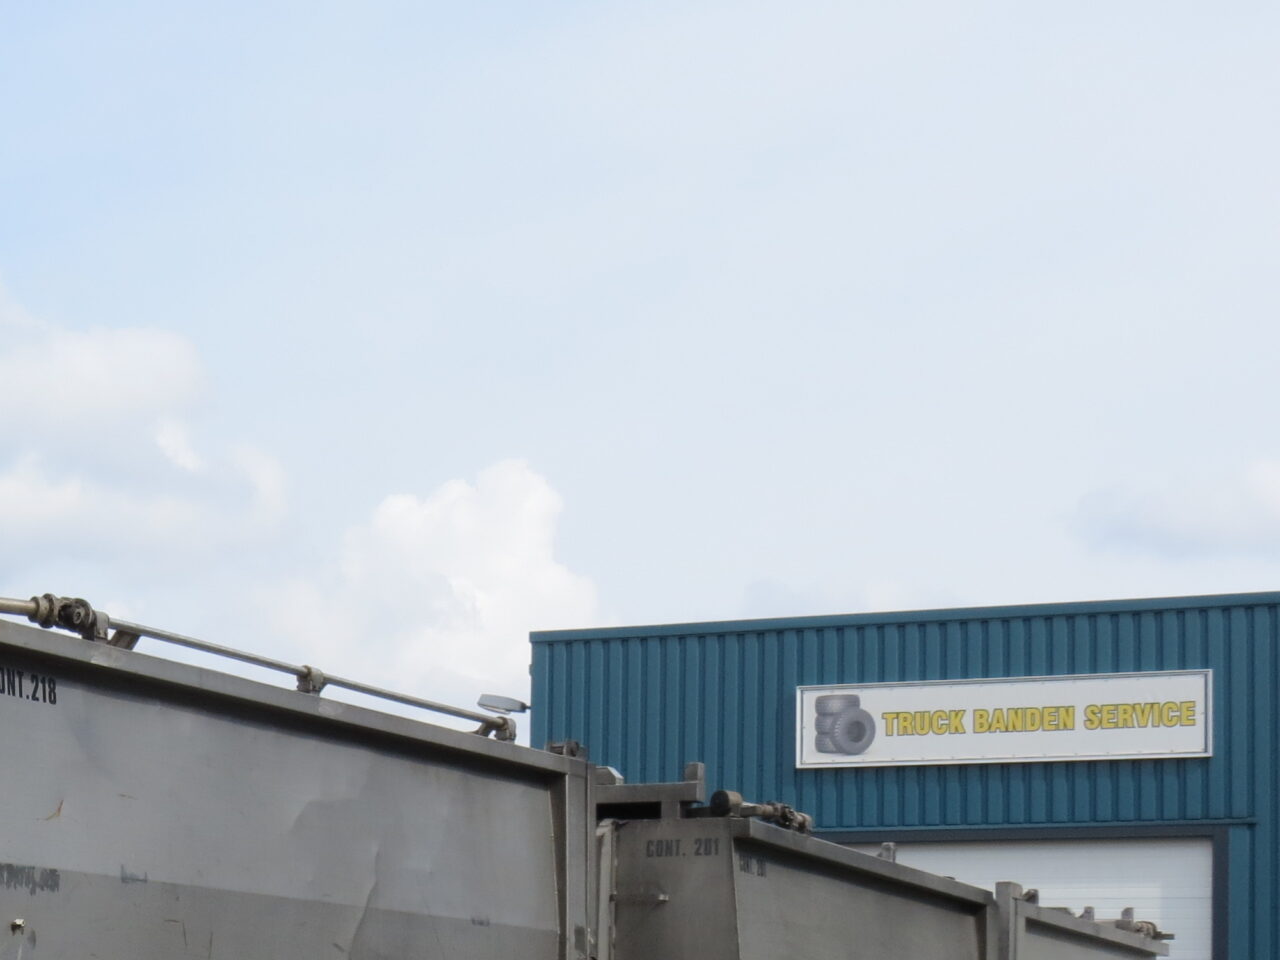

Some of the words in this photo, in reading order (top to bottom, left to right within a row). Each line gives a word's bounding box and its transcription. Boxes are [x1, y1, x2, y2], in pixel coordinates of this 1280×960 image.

[882, 709, 966, 736] TRUCK
[973, 706, 1075, 733] BANDEN
[1084, 701, 1197, 730] SERVICE
[646, 839, 687, 858] CONT.
[694, 837, 720, 856] 201
